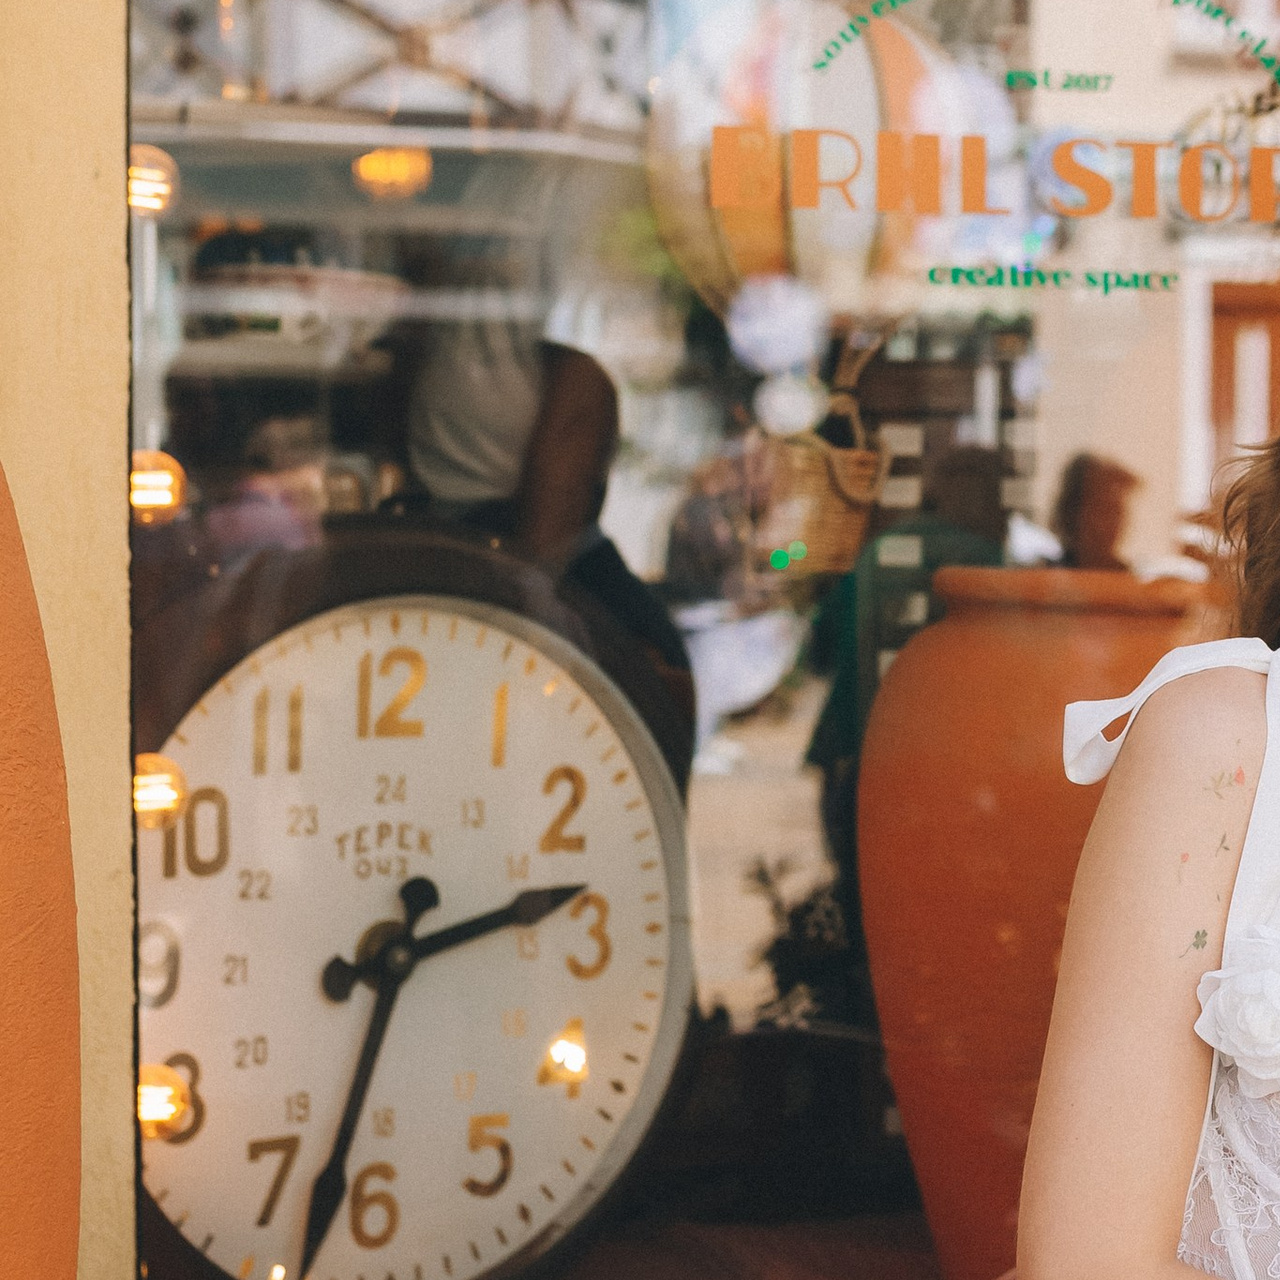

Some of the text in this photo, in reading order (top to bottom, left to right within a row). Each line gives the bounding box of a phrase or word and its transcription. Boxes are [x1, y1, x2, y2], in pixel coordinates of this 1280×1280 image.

[928, 260, 1180, 296] creative space
[253, 684, 304, 776] 11
[357, 644, 427, 741] 12
[490, 681, 510, 769] 1
[163, 786, 231, 880] 10
[286, 803, 319, 837] 23
[374, 773, 407, 805] 24
[538, 764, 588, 854] 2
[238, 867, 273, 901] 22
[139, 920, 181, 1008] 9
[222, 954, 249, 987] 21
[565, 891, 613, 981] 3
[234, 1034, 269, 1070] 20
[284, 1090, 311, 1124] 19
[246, 1134, 301, 1228] 7
[462, 1111, 514, 1198] 5
[349, 1160, 399, 1251] 6
